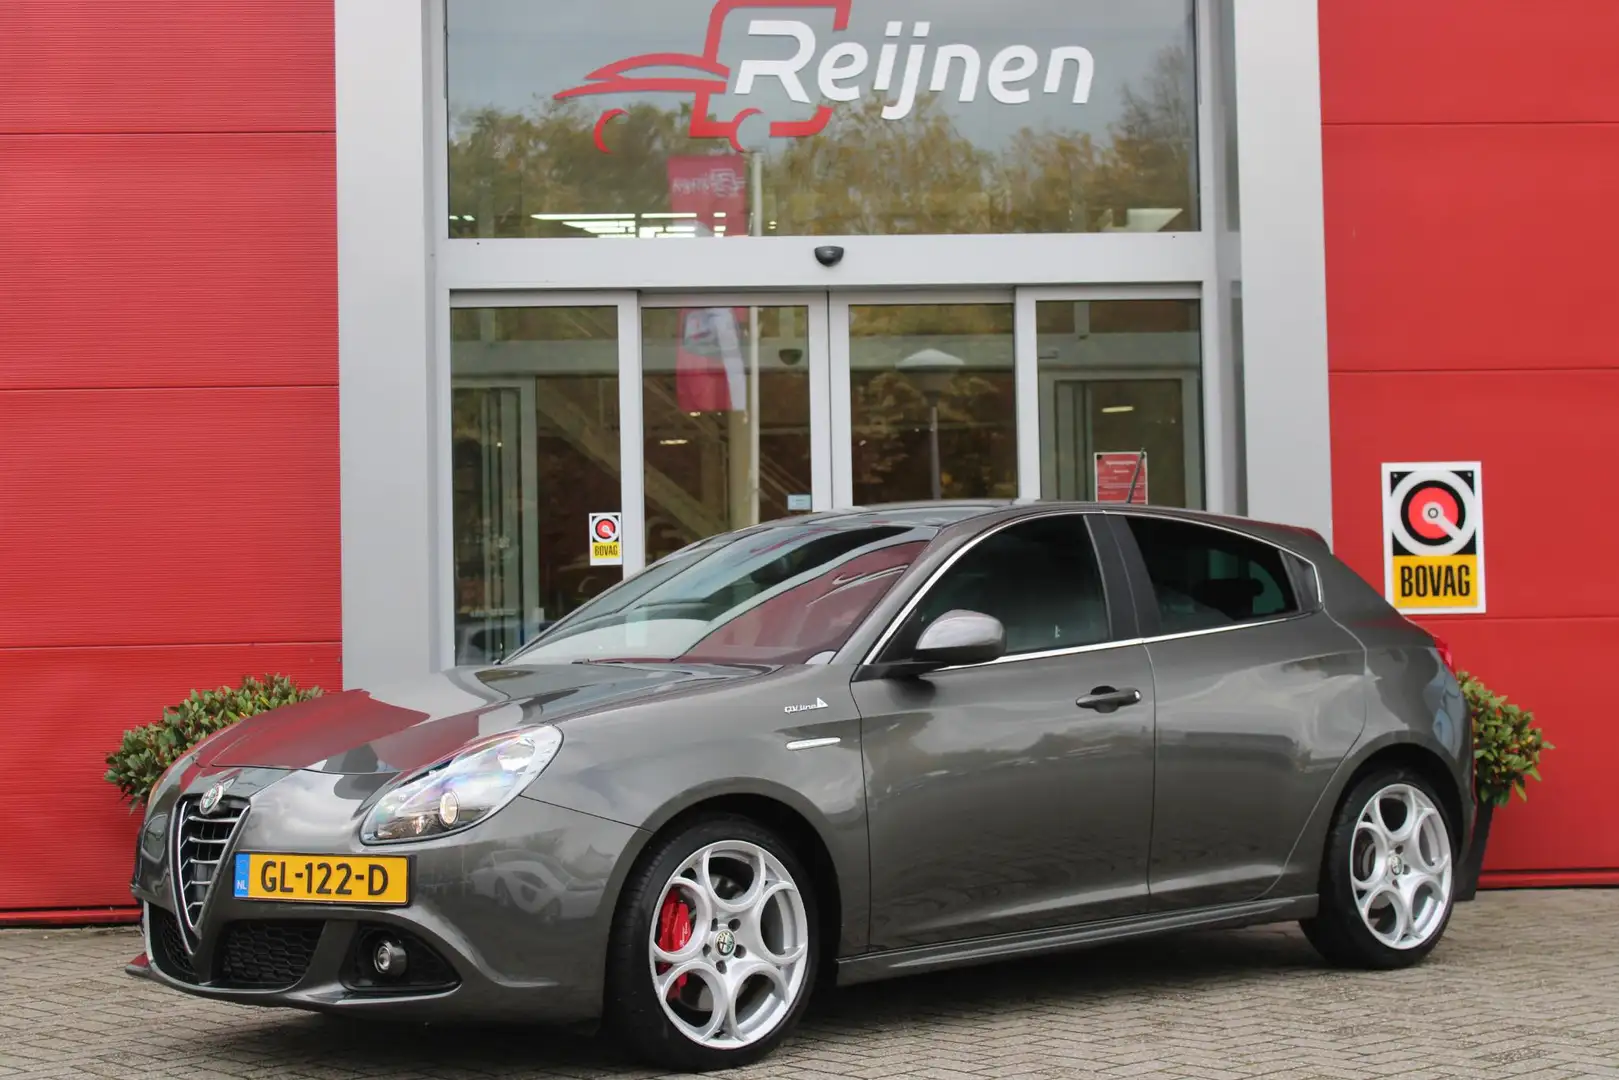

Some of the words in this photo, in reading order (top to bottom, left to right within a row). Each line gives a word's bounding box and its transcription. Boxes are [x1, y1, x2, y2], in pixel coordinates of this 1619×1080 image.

[734, 19, 1095, 120] Reijnen
[594, 545, 618, 557] BOVAG
[1400, 564, 1470, 597] BOVAG
[236, 879, 247, 891] NL
[261, 860, 389, 896] GL-122-D
